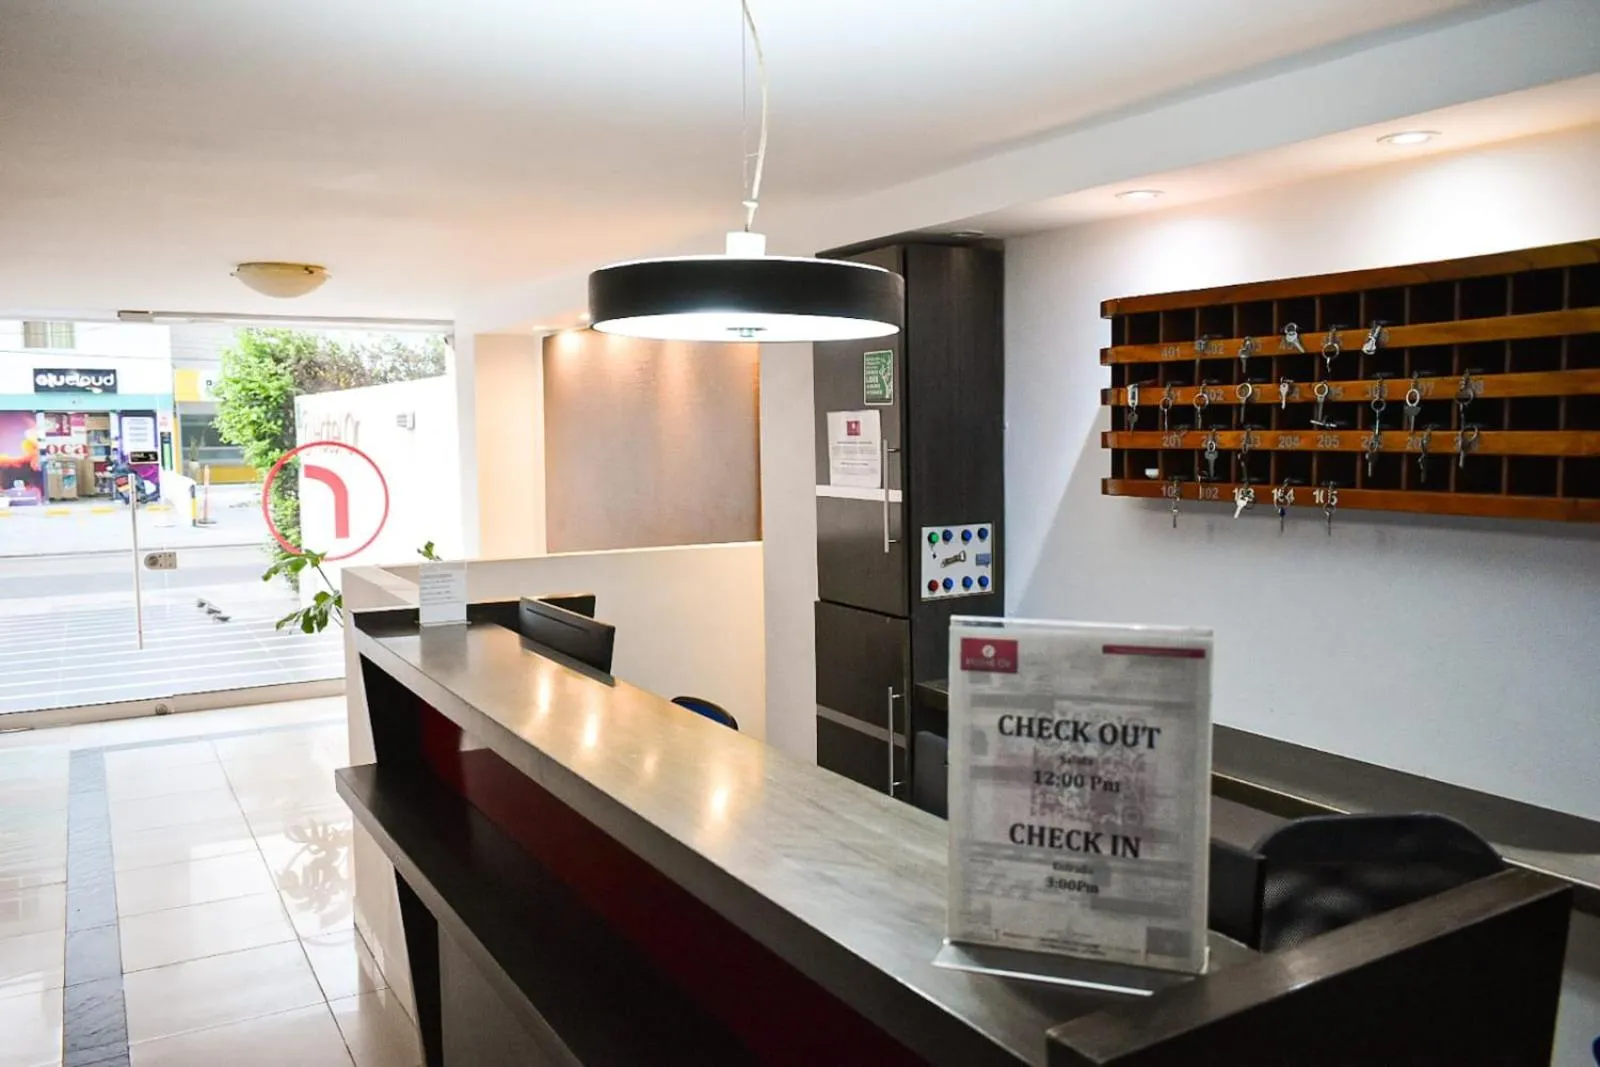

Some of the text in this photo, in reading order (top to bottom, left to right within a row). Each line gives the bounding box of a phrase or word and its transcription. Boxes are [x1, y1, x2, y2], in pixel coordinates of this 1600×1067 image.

[1317, 434, 1340, 448] 205
[997, 714, 1161, 749] CHECK OUT
[1033, 770, 1121, 793] 12:00 Pm
[1009, 823, 1142, 858] CHECK IN
